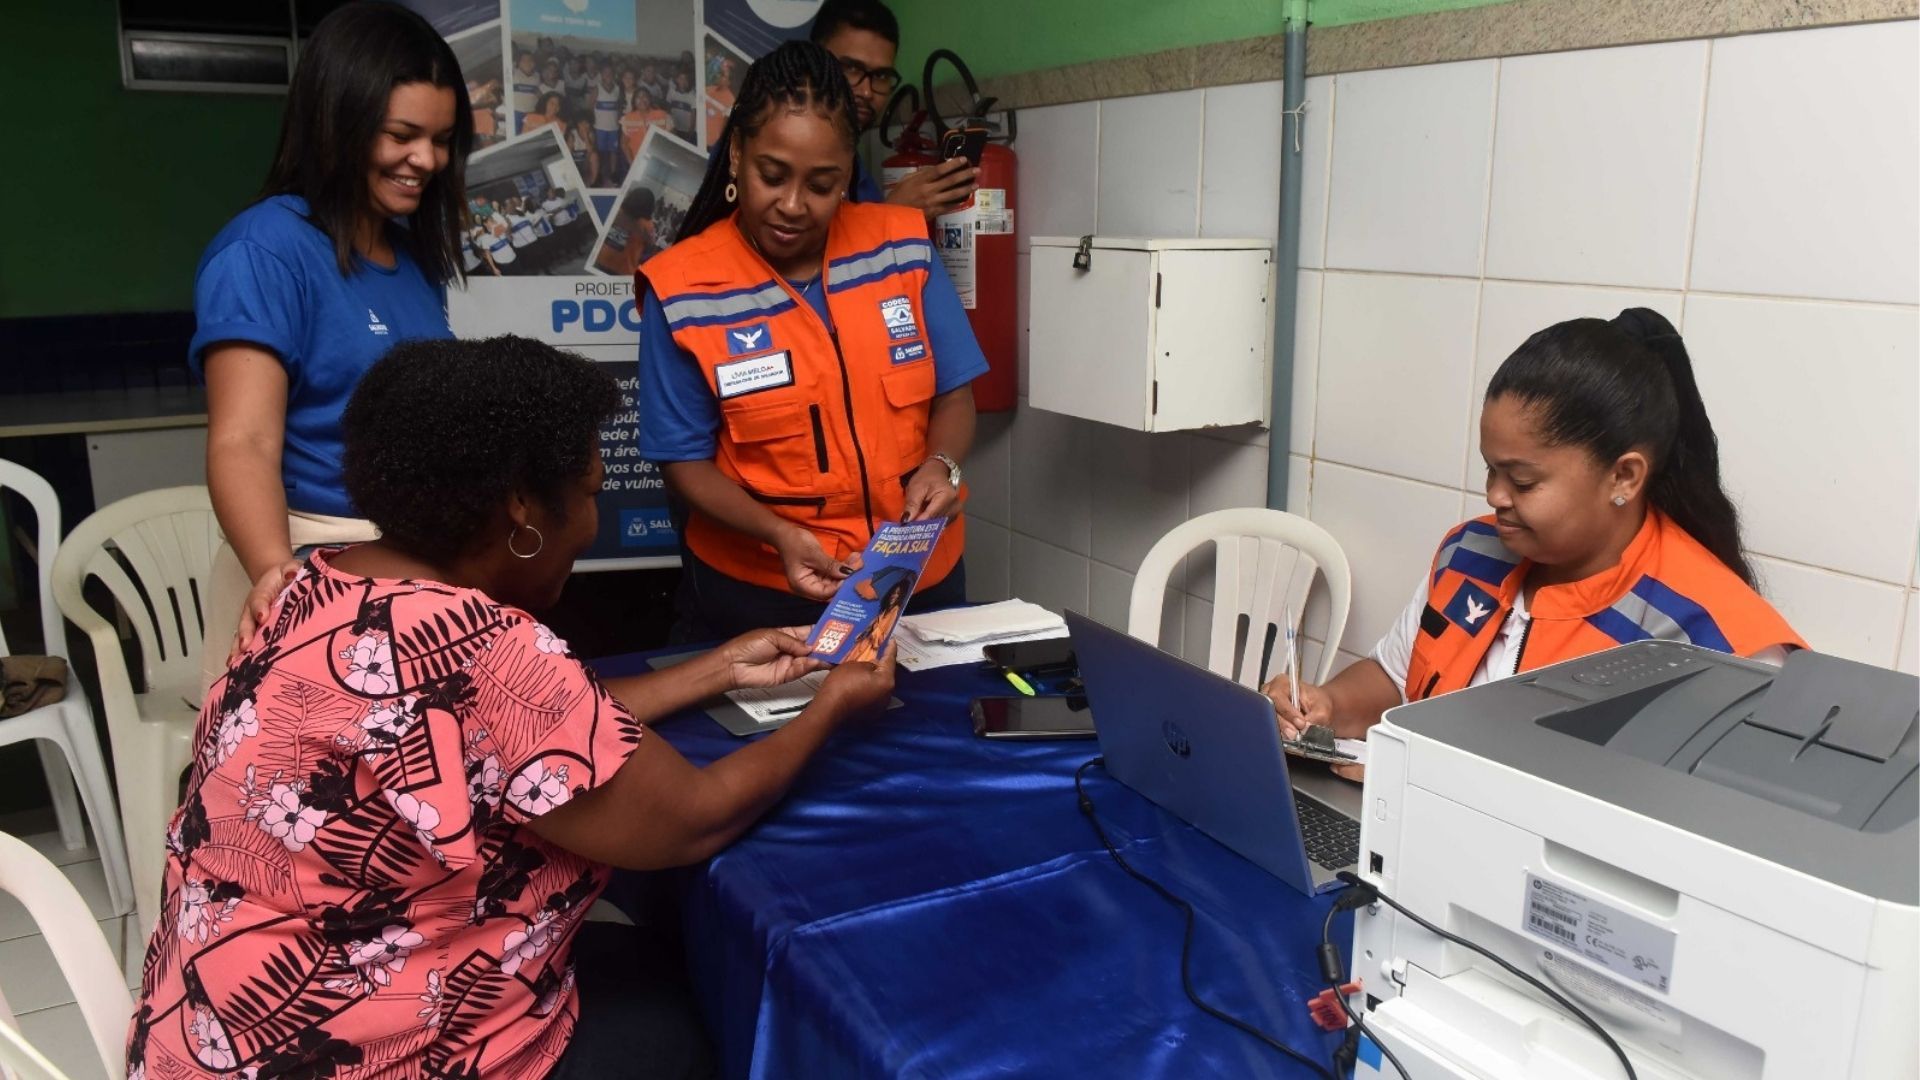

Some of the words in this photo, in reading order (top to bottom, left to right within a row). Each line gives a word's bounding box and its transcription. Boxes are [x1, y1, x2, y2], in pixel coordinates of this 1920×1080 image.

[599, 427, 629, 441] ede
[614, 444, 640, 457] áre
[633, 460, 652, 473] de
[602, 478, 621, 490] de
[871, 540, 902, 558] FAÇA
[815, 637, 841, 653] 199
